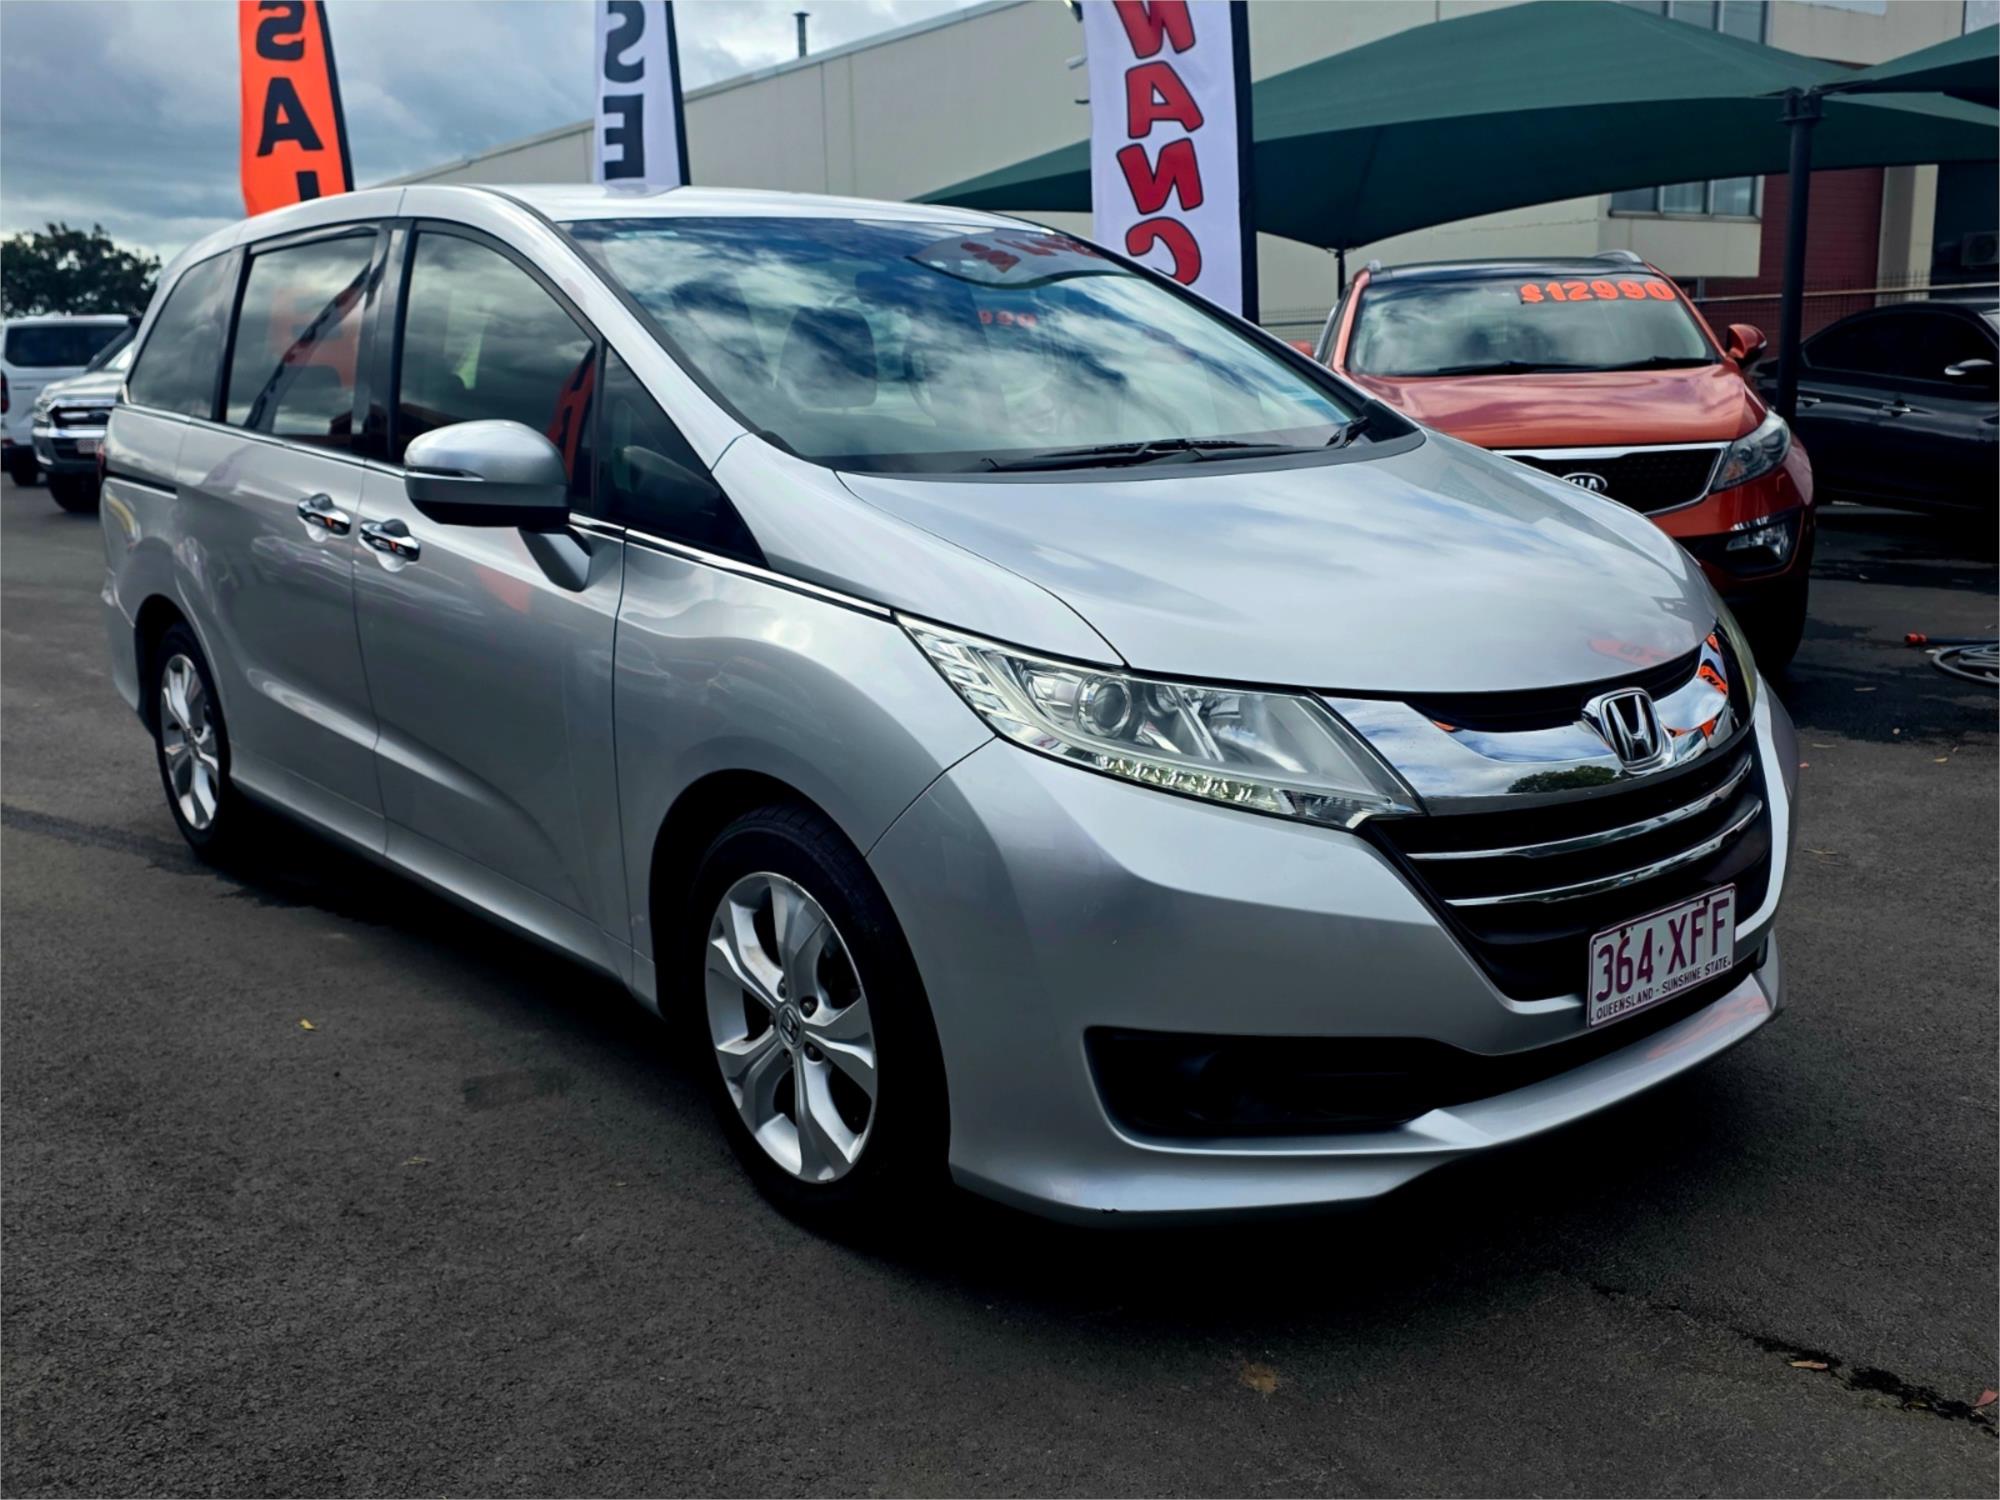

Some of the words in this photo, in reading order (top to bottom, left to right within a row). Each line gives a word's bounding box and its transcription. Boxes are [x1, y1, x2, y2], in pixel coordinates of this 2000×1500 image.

[1520, 280, 1676, 303] $12990
[1596, 988, 1654, 1019] QUEENSLAND
[1662, 968, 1702, 994] SUNSHINE
[1704, 956, 1728, 976] STATE
